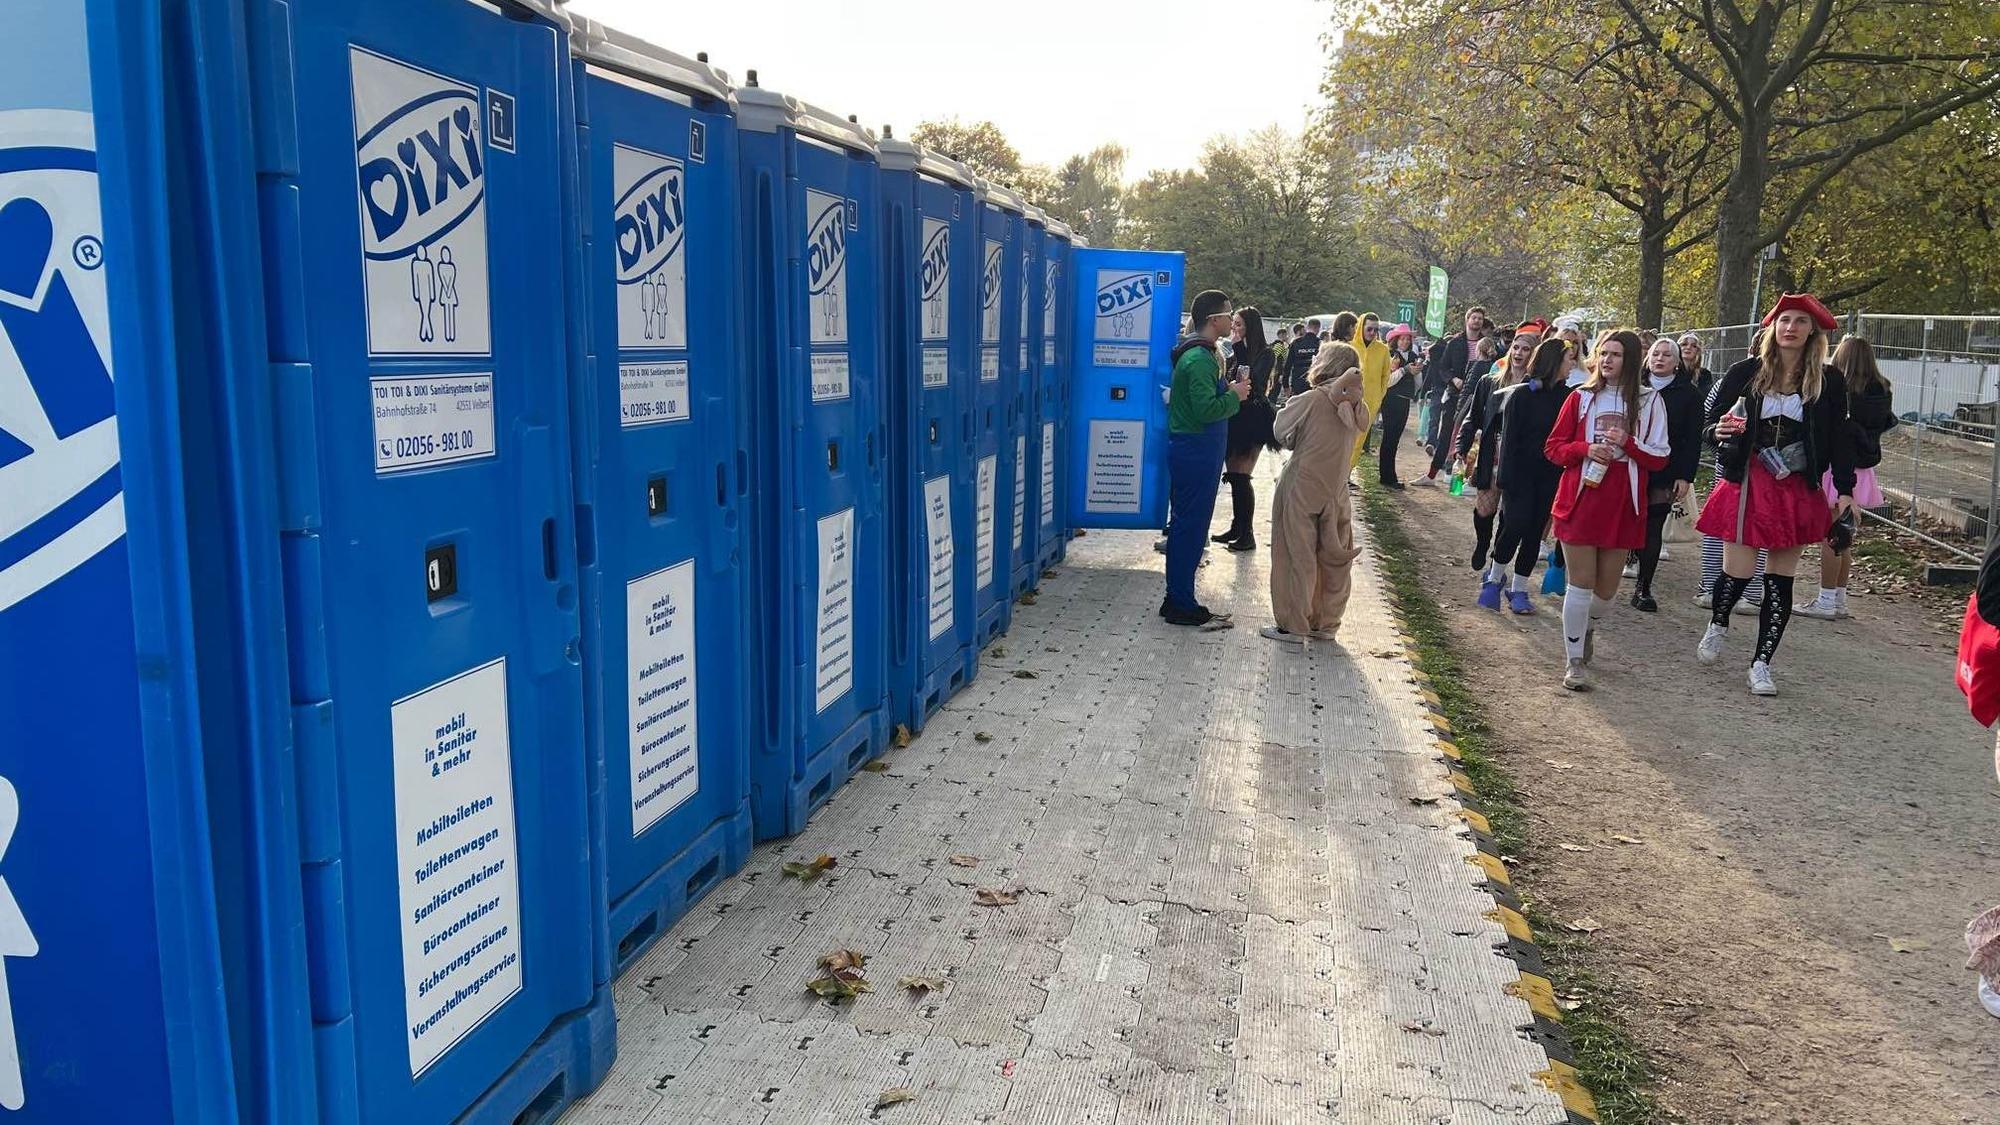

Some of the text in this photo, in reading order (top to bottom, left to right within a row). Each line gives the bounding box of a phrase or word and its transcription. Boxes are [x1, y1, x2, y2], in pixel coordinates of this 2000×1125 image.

[1400, 308, 1412, 322] 10
[374, 382, 489, 398] TOI TOI & DIXI Sanitärsysteme GmbH
[376, 402, 428, 418] Bahnhofstraße
[631, 402, 651, 417] 02056
[656, 401, 666, 415] 981
[668, 400, 676, 413] 00
[396, 434, 434, 458] 02056
[442, 432, 459, 452] 981
[462, 430, 473, 448] 00
[645, 605, 676, 626] in Sanitär
[652, 594, 670, 610] mobil
[650, 619, 672, 636] & mehr
[640, 653, 684, 681] Mobiltoiletten
[638, 676, 687, 706] Toilettenwagen
[436, 712, 465, 740] mobil
[636, 698, 690, 732] Sanitärcontainer
[424, 728, 477, 763] in Sanitär
[641, 724, 686, 755] Bürocontainer
[432, 748, 471, 778] & mehr
[638, 745, 690, 782] Sicherungszäune
[634, 765, 695, 811] Veranstaltungsservice
[416, 795, 493, 846] Mobiltoiletten
[414, 828, 498, 884] Toilettenwagen
[414, 859, 504, 924] Sanitärcontainer
[423, 897, 500, 956] Bürocontainer
[418, 925, 508, 998] Sicherungszäune
[412, 952, 516, 1040] Veranstaltungsservice
